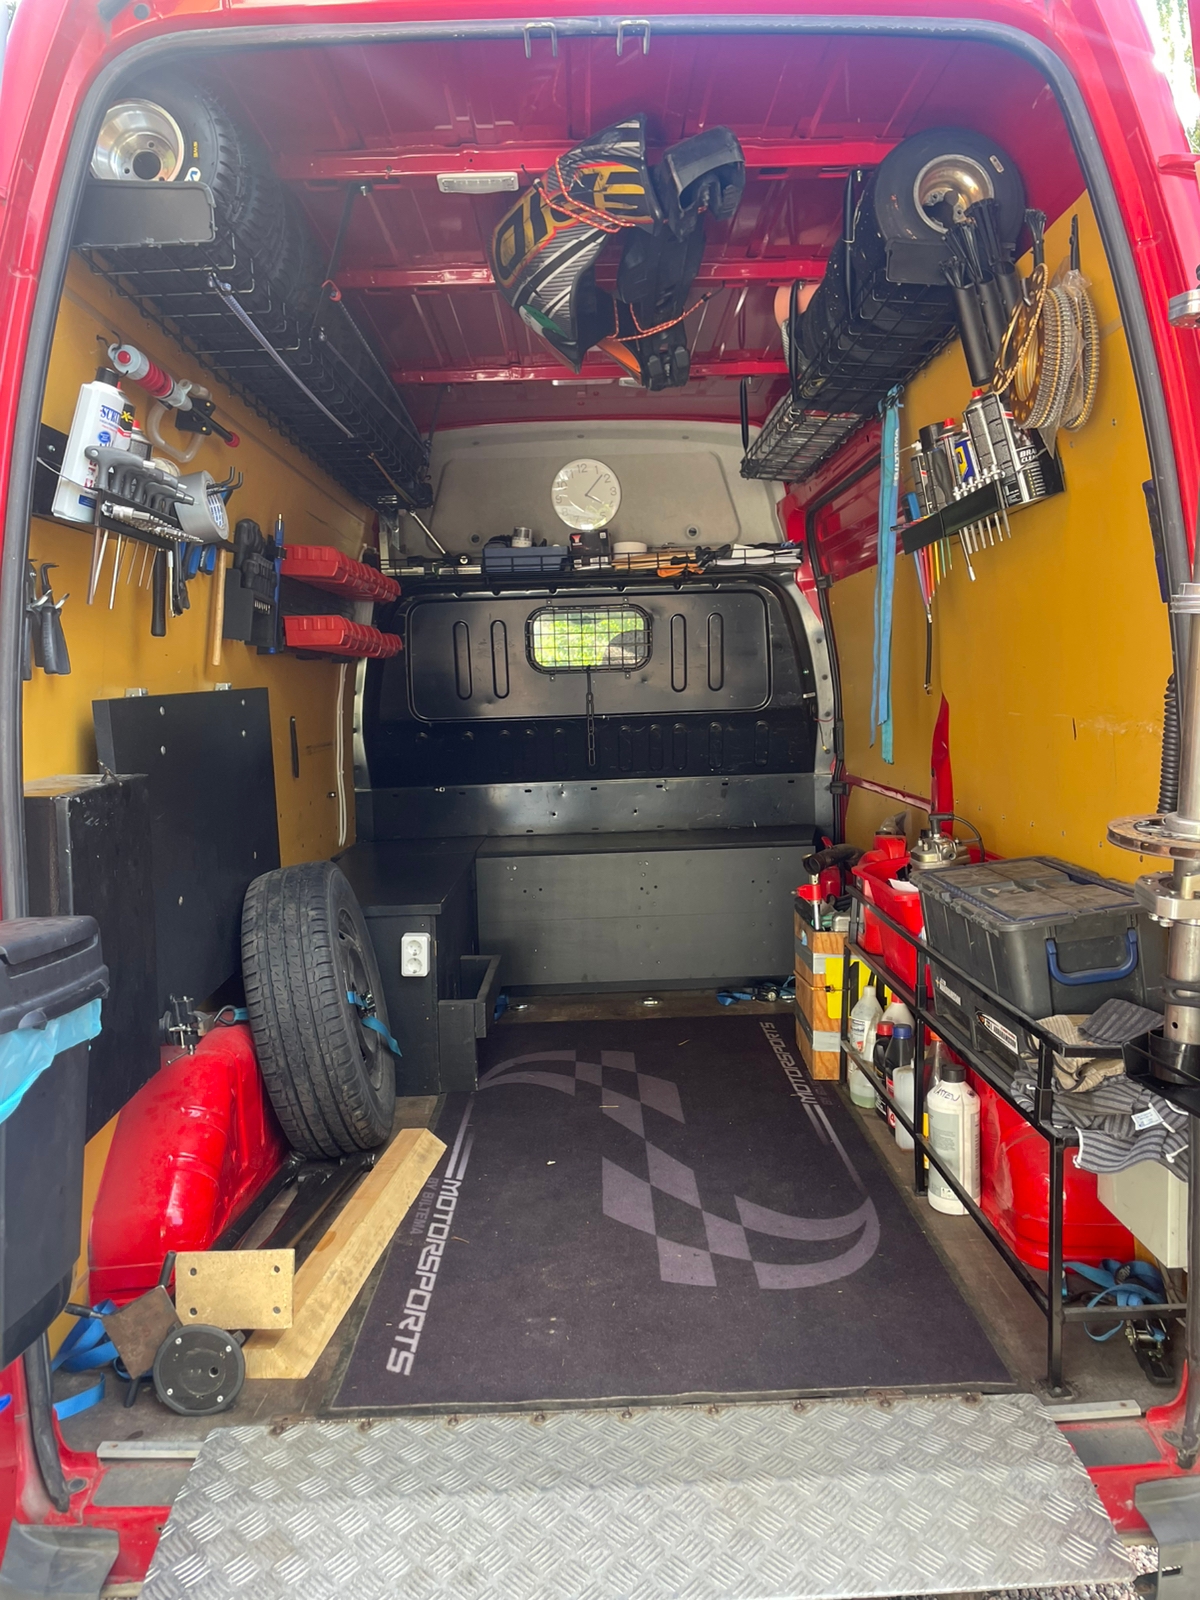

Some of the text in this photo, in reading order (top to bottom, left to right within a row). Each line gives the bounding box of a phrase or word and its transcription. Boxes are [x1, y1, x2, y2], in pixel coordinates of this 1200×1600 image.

[577, 463, 588, 473] 12
[594, 465, 599, 474] 1
[603, 473, 612, 483] 2
[557, 481, 568, 490] 10
[609, 486, 617, 496] 3
[555, 495, 562, 504] 9
[561, 507, 568, 516] 8
[760, 1021, 818, 1104] MOTORSPORTS
[410, 1177, 439, 1236] BY BILTEMA
[386, 1179, 462, 1376] MOTORSPORTS
